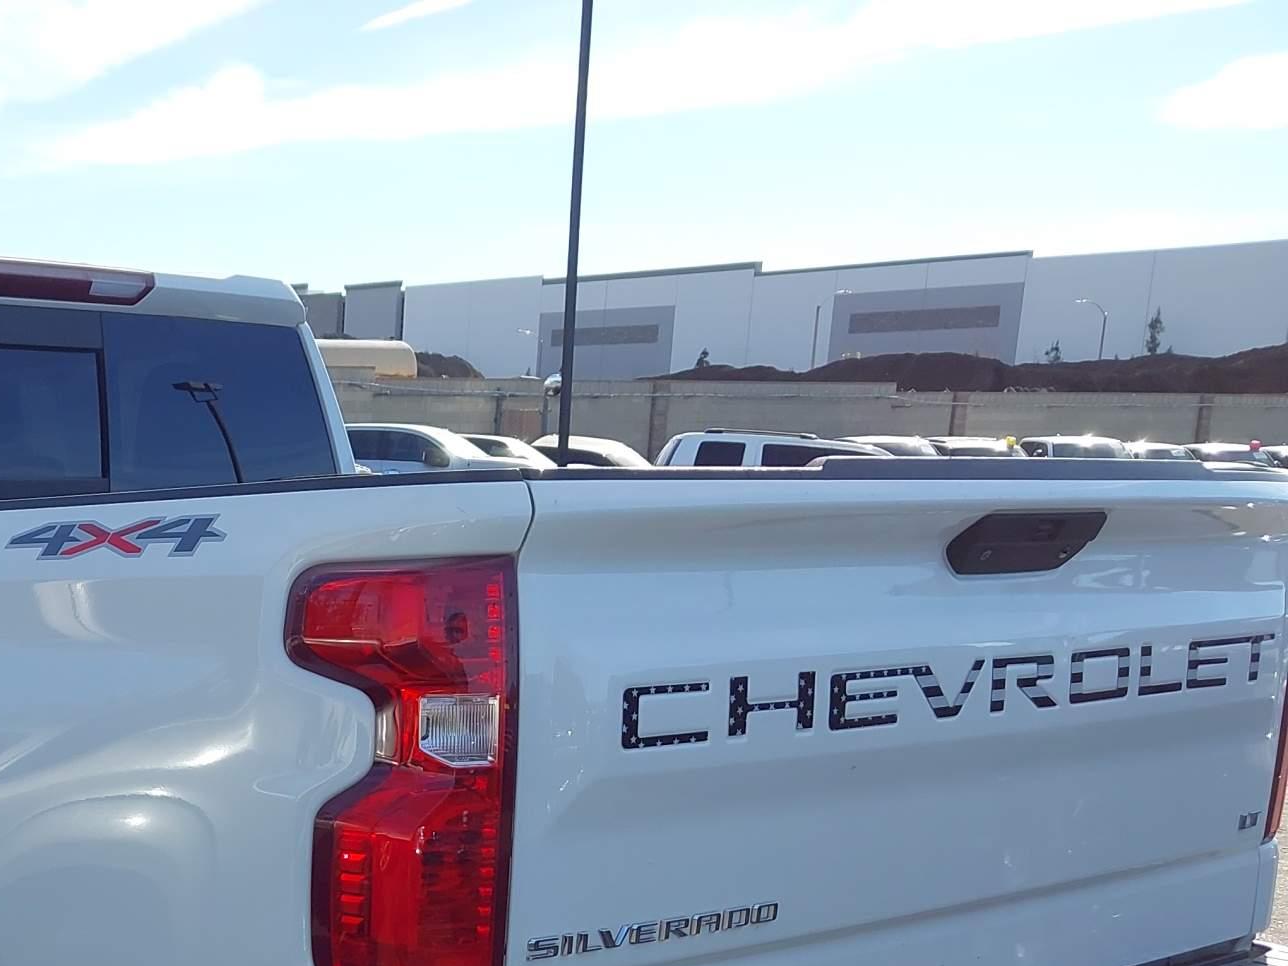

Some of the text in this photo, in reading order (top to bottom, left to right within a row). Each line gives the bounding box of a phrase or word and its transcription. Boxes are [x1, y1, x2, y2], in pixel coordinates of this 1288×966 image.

[621, 633, 1275, 750] CHEVROLET
[1238, 810, 1262, 830] LT
[526, 901, 779, 961] SILVERADO
